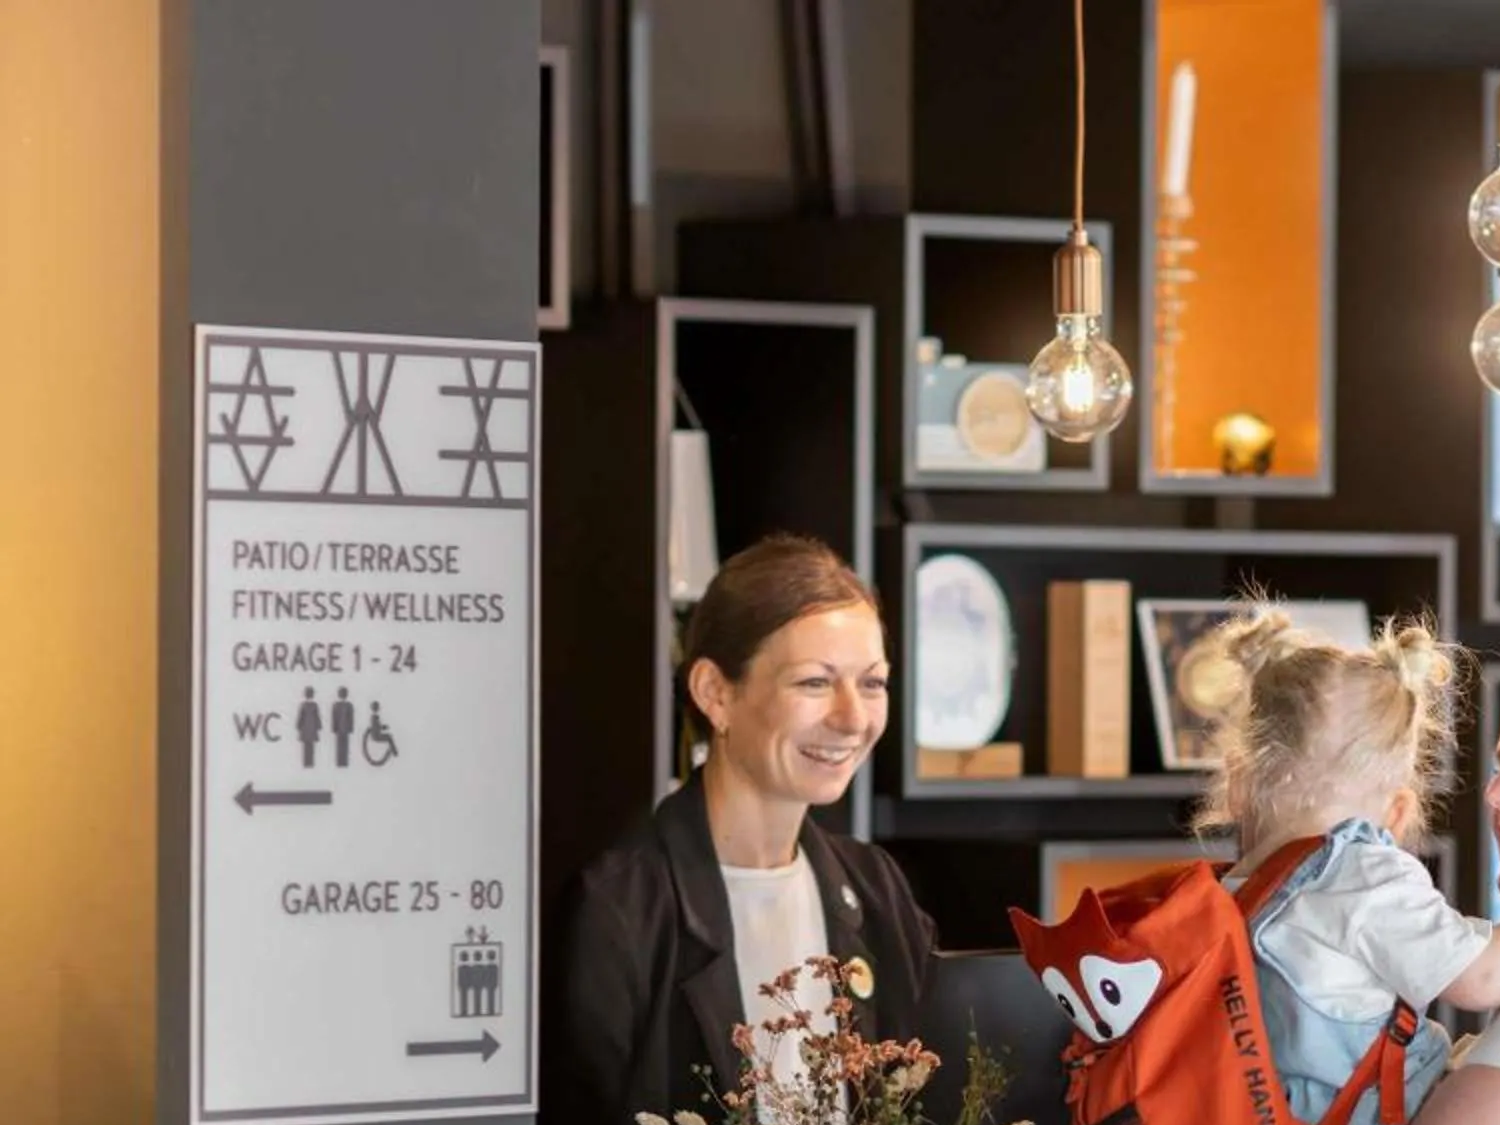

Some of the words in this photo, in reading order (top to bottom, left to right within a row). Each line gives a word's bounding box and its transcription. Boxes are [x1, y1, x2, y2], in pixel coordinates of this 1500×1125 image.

[232, 641, 344, 674] GARAGE
[352, 645, 362, 673] 1
[389, 644, 418, 674] 24
[232, 712, 282, 743] WC
[281, 881, 400, 915] GARAGE
[409, 881, 441, 912] 25
[469, 880, 504, 911] 80
[1219, 975, 1260, 1058] HELLY
